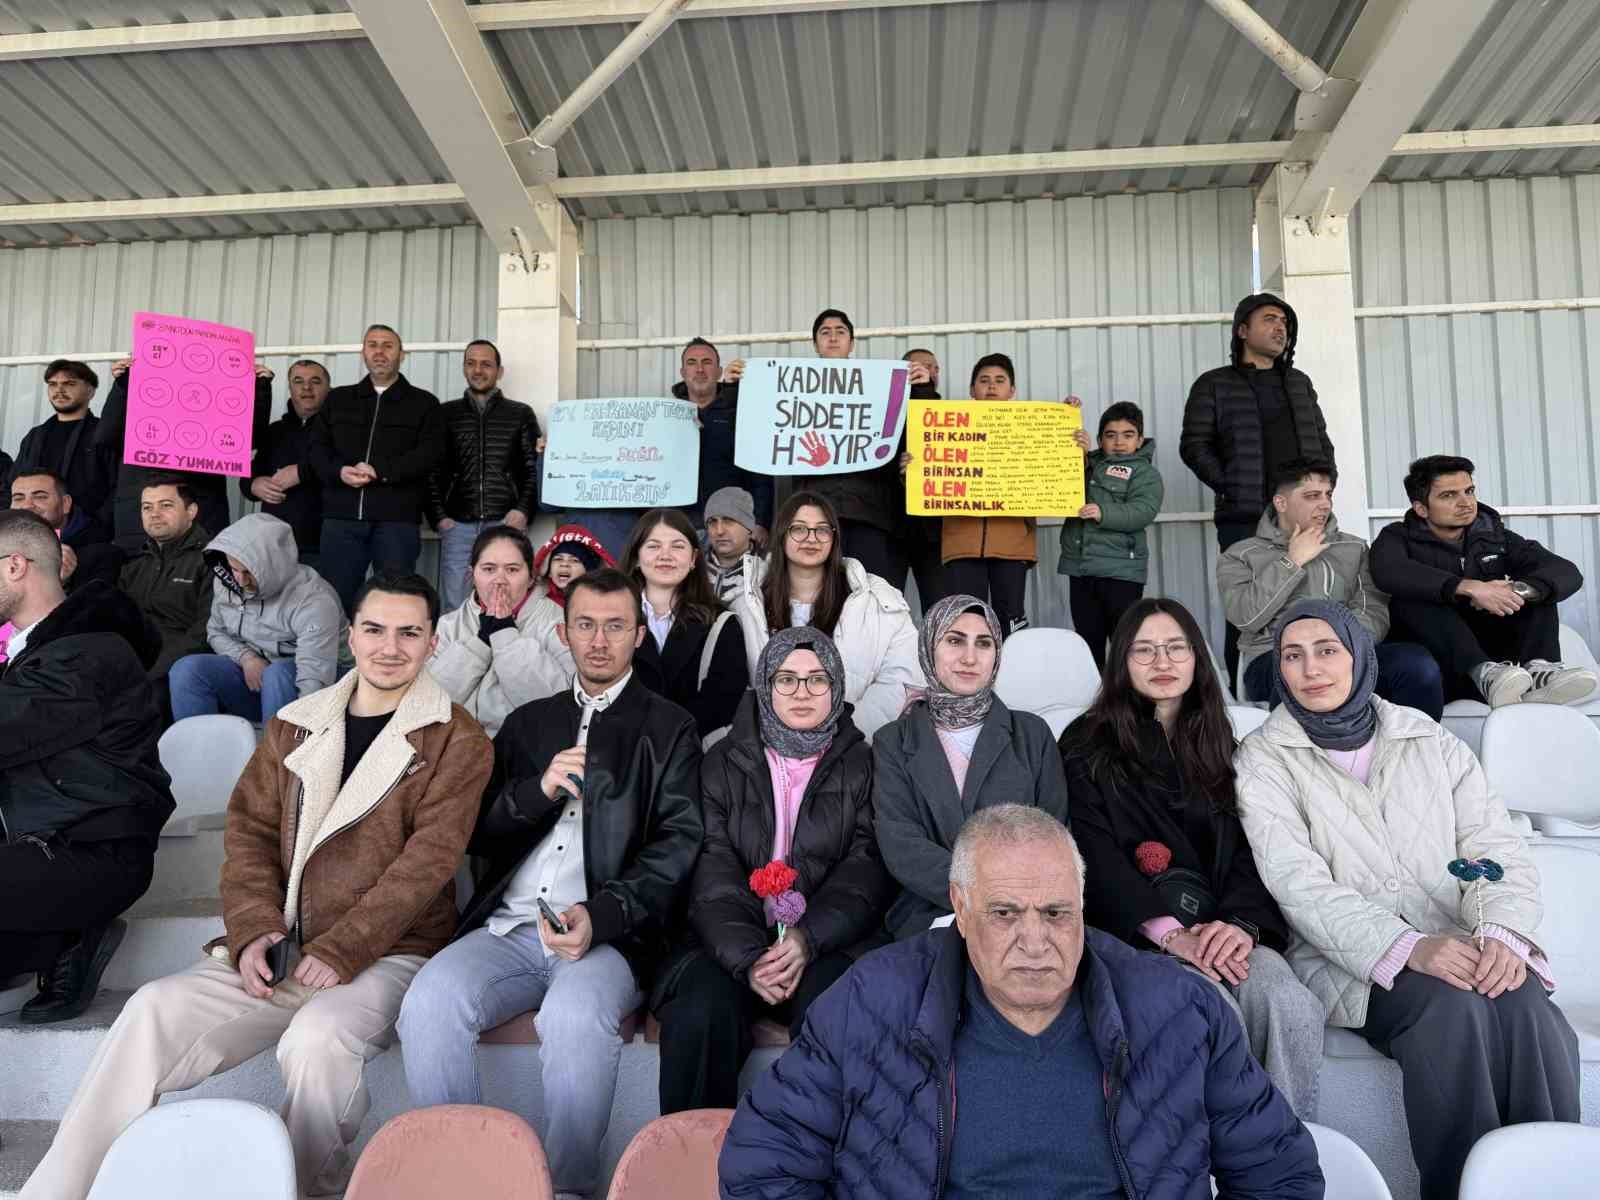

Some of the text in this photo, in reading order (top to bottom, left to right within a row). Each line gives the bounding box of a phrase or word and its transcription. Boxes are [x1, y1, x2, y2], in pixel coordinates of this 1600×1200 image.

[775, 396, 872, 433] ŞİDDETE
[923, 408, 970, 427] ÖLEN
[923, 429, 945, 442] BİR
[948, 431, 987, 441] KADIN
[134, 448, 170, 465] GÖZ
[923, 444, 968, 463] ÖLEN
[923, 477, 967, 497] ÖLEN
